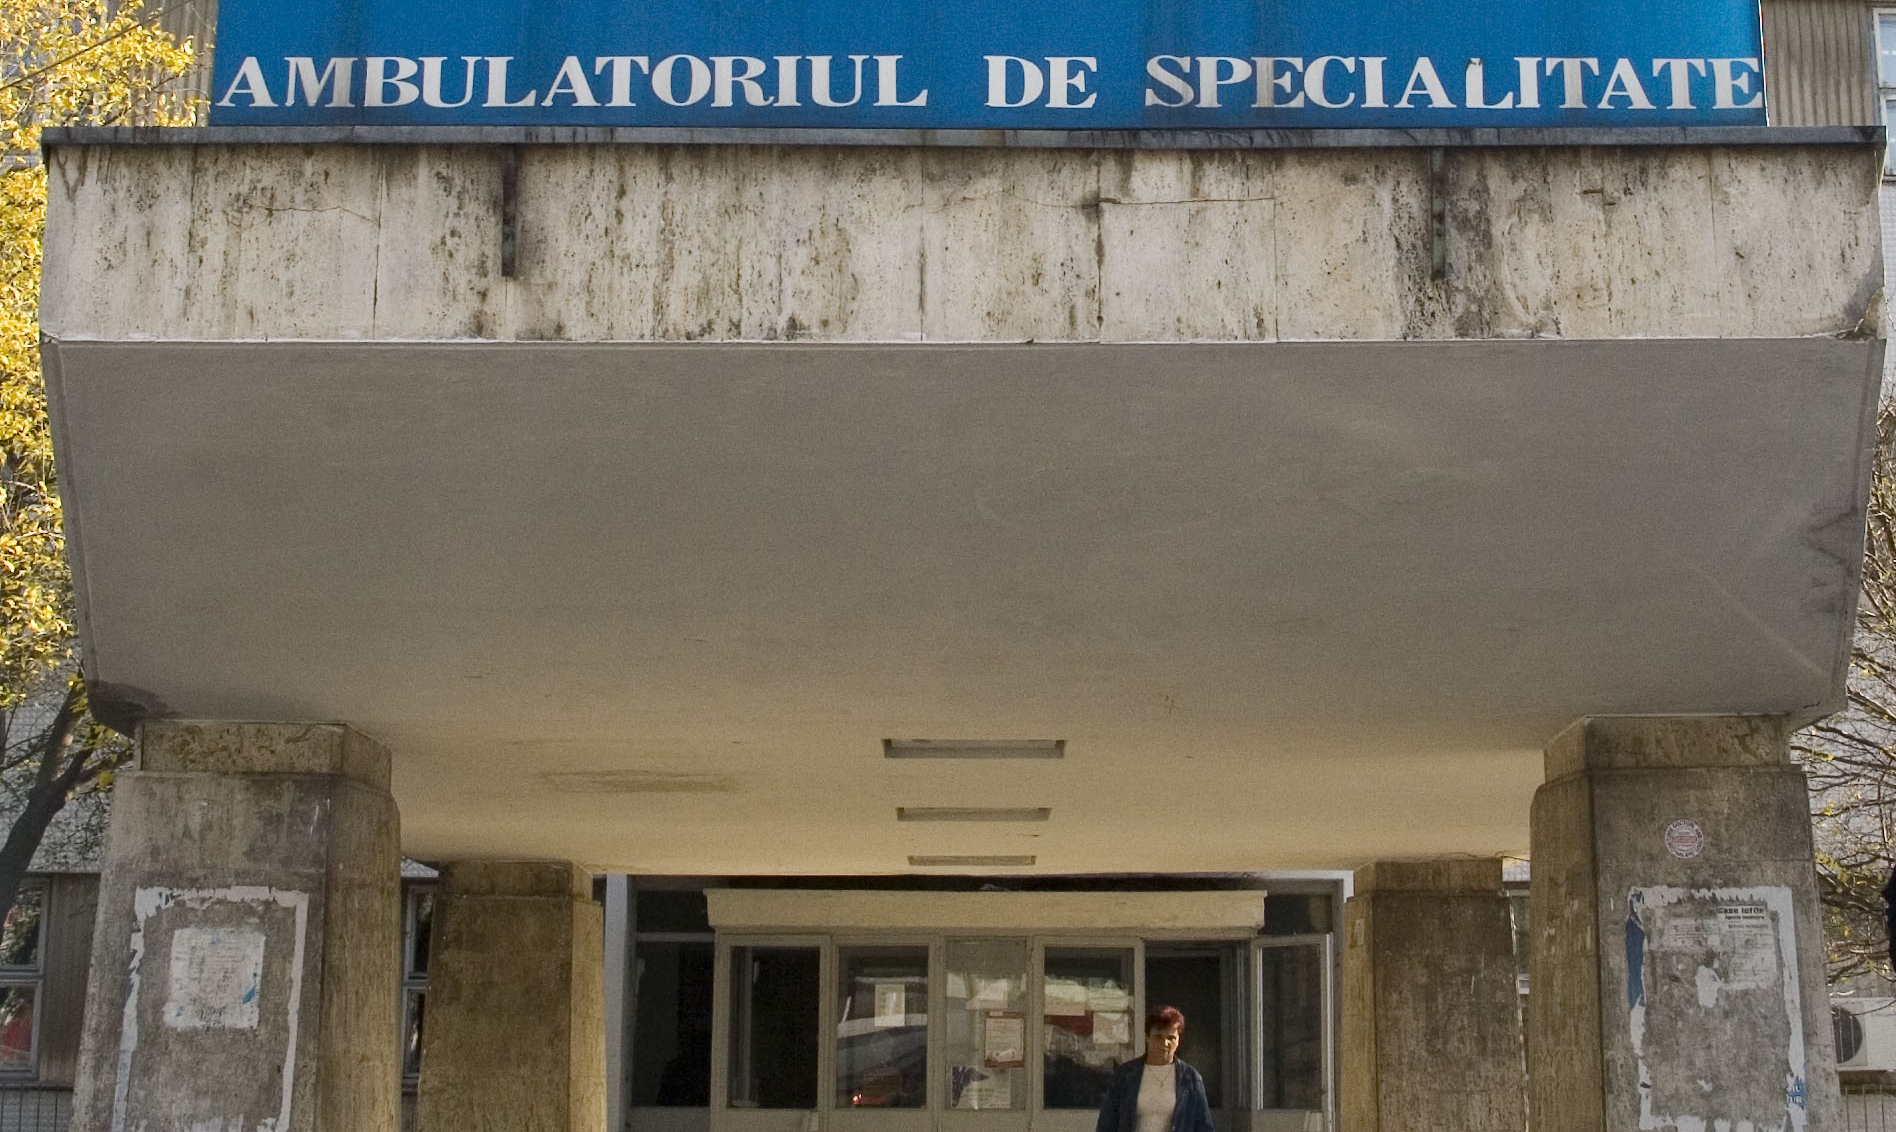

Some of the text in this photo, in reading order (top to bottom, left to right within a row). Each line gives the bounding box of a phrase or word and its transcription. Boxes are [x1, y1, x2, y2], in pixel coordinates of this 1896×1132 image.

[216, 55, 1764, 110] AMBULATORIUL DE SPECIALITATE
